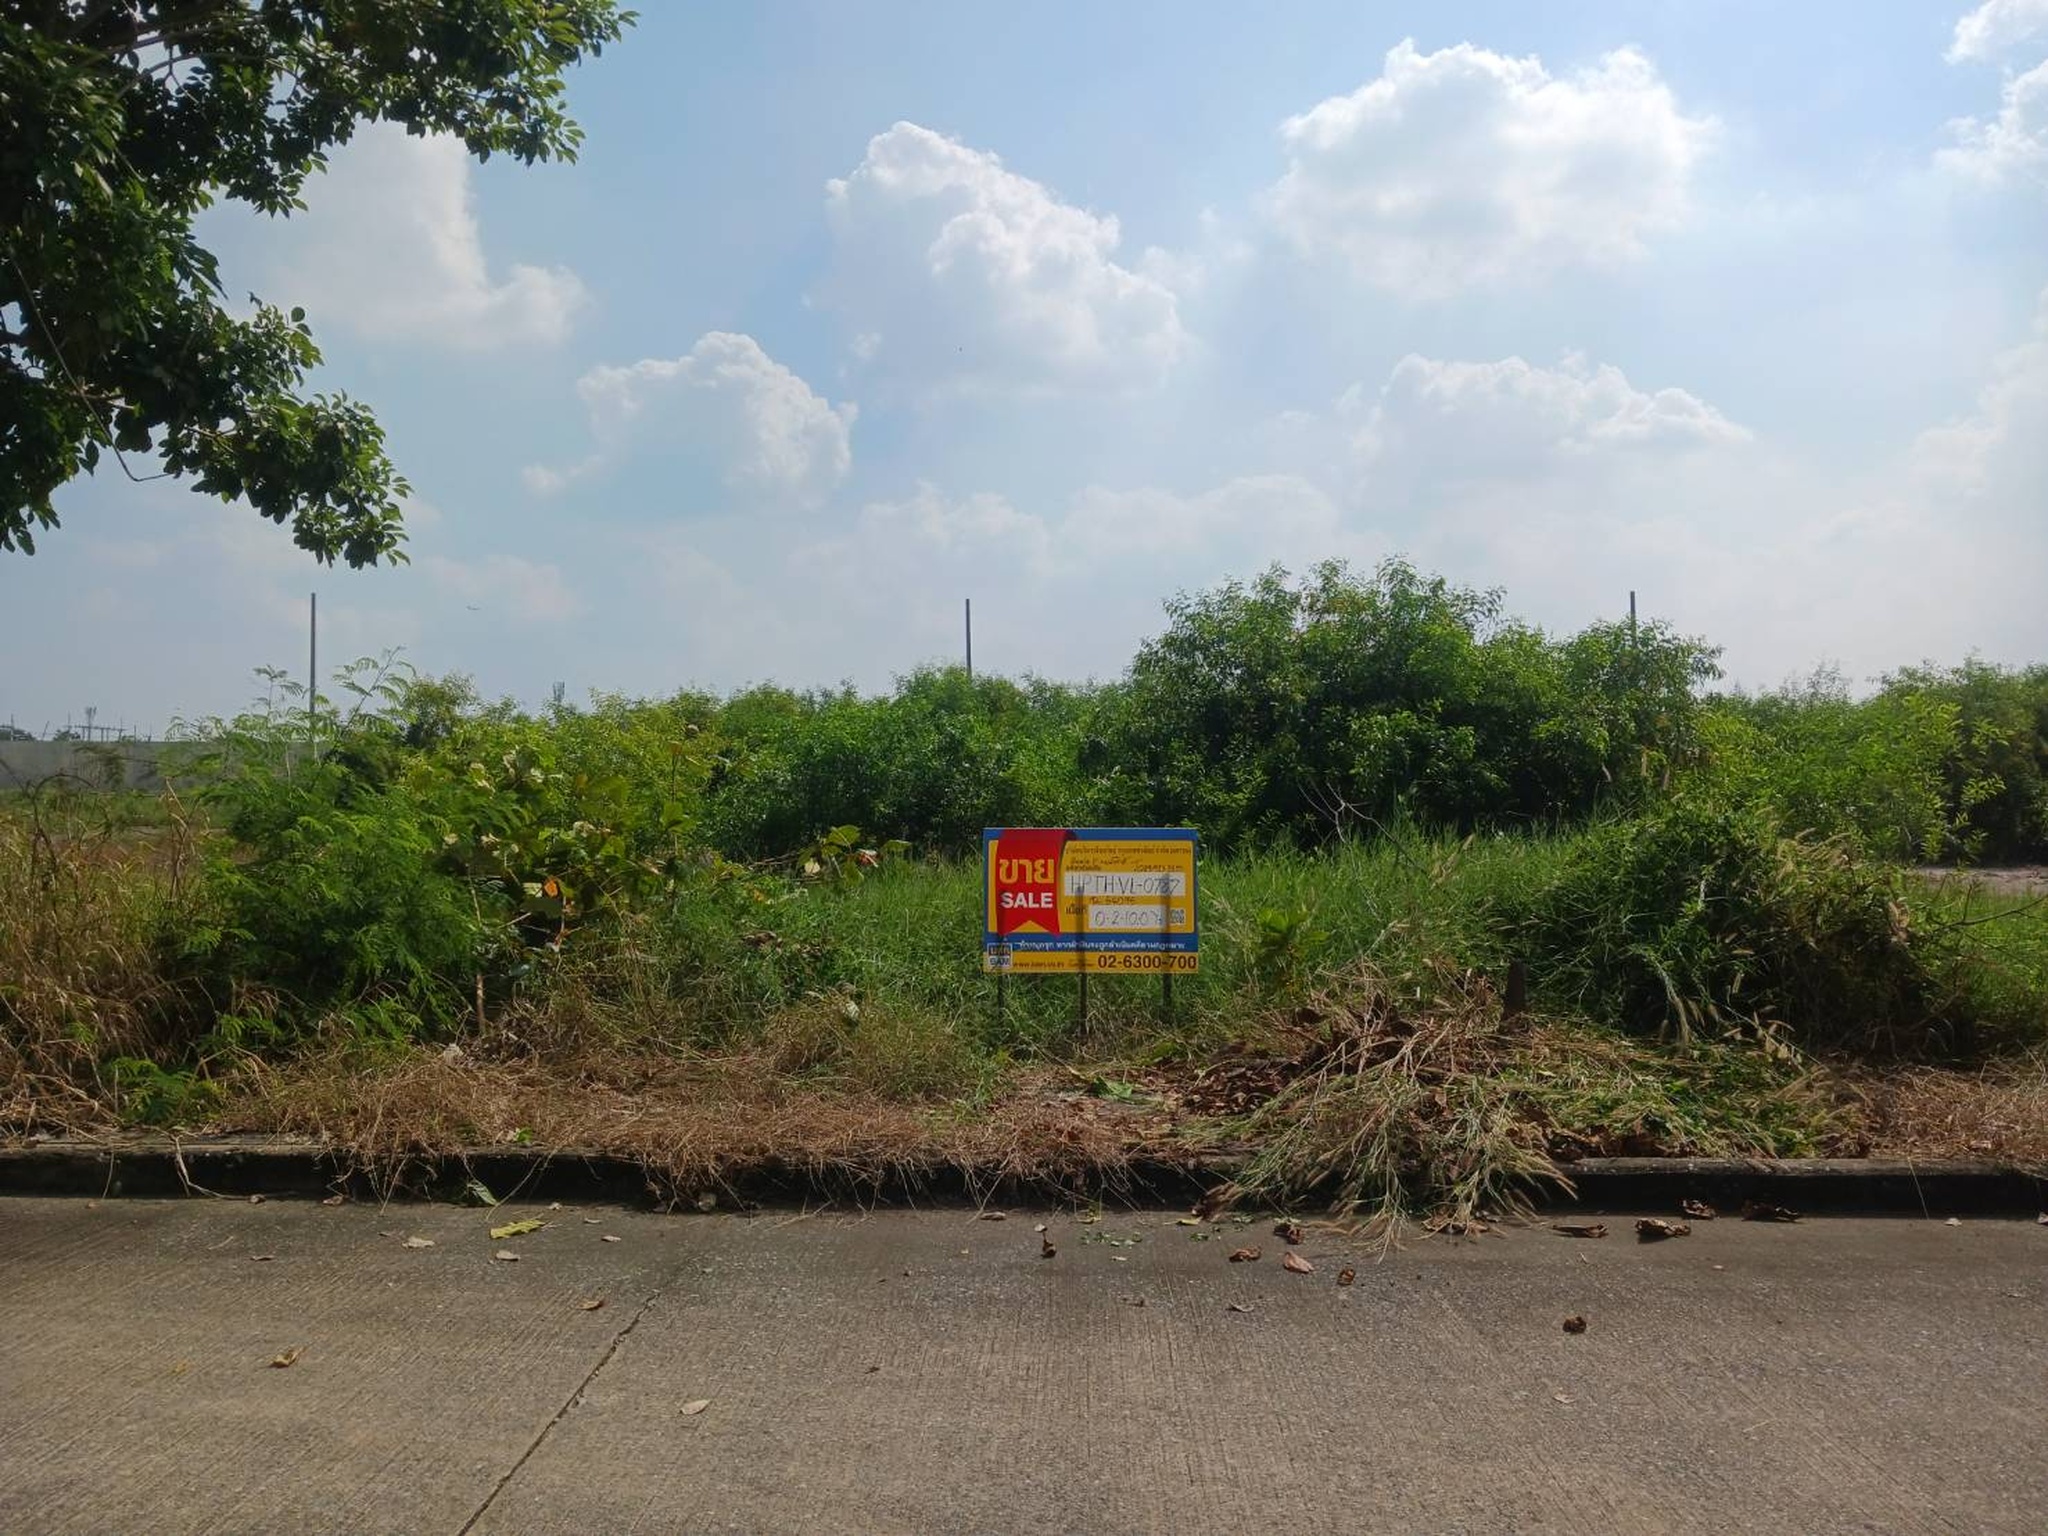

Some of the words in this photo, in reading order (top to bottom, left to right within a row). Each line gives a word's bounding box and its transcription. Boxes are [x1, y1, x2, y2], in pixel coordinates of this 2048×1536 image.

[999, 858, 1055, 884] ขาย
[1001, 892, 1054, 909] SALE
[1098, 954, 1197, 970] 02-6300-700
